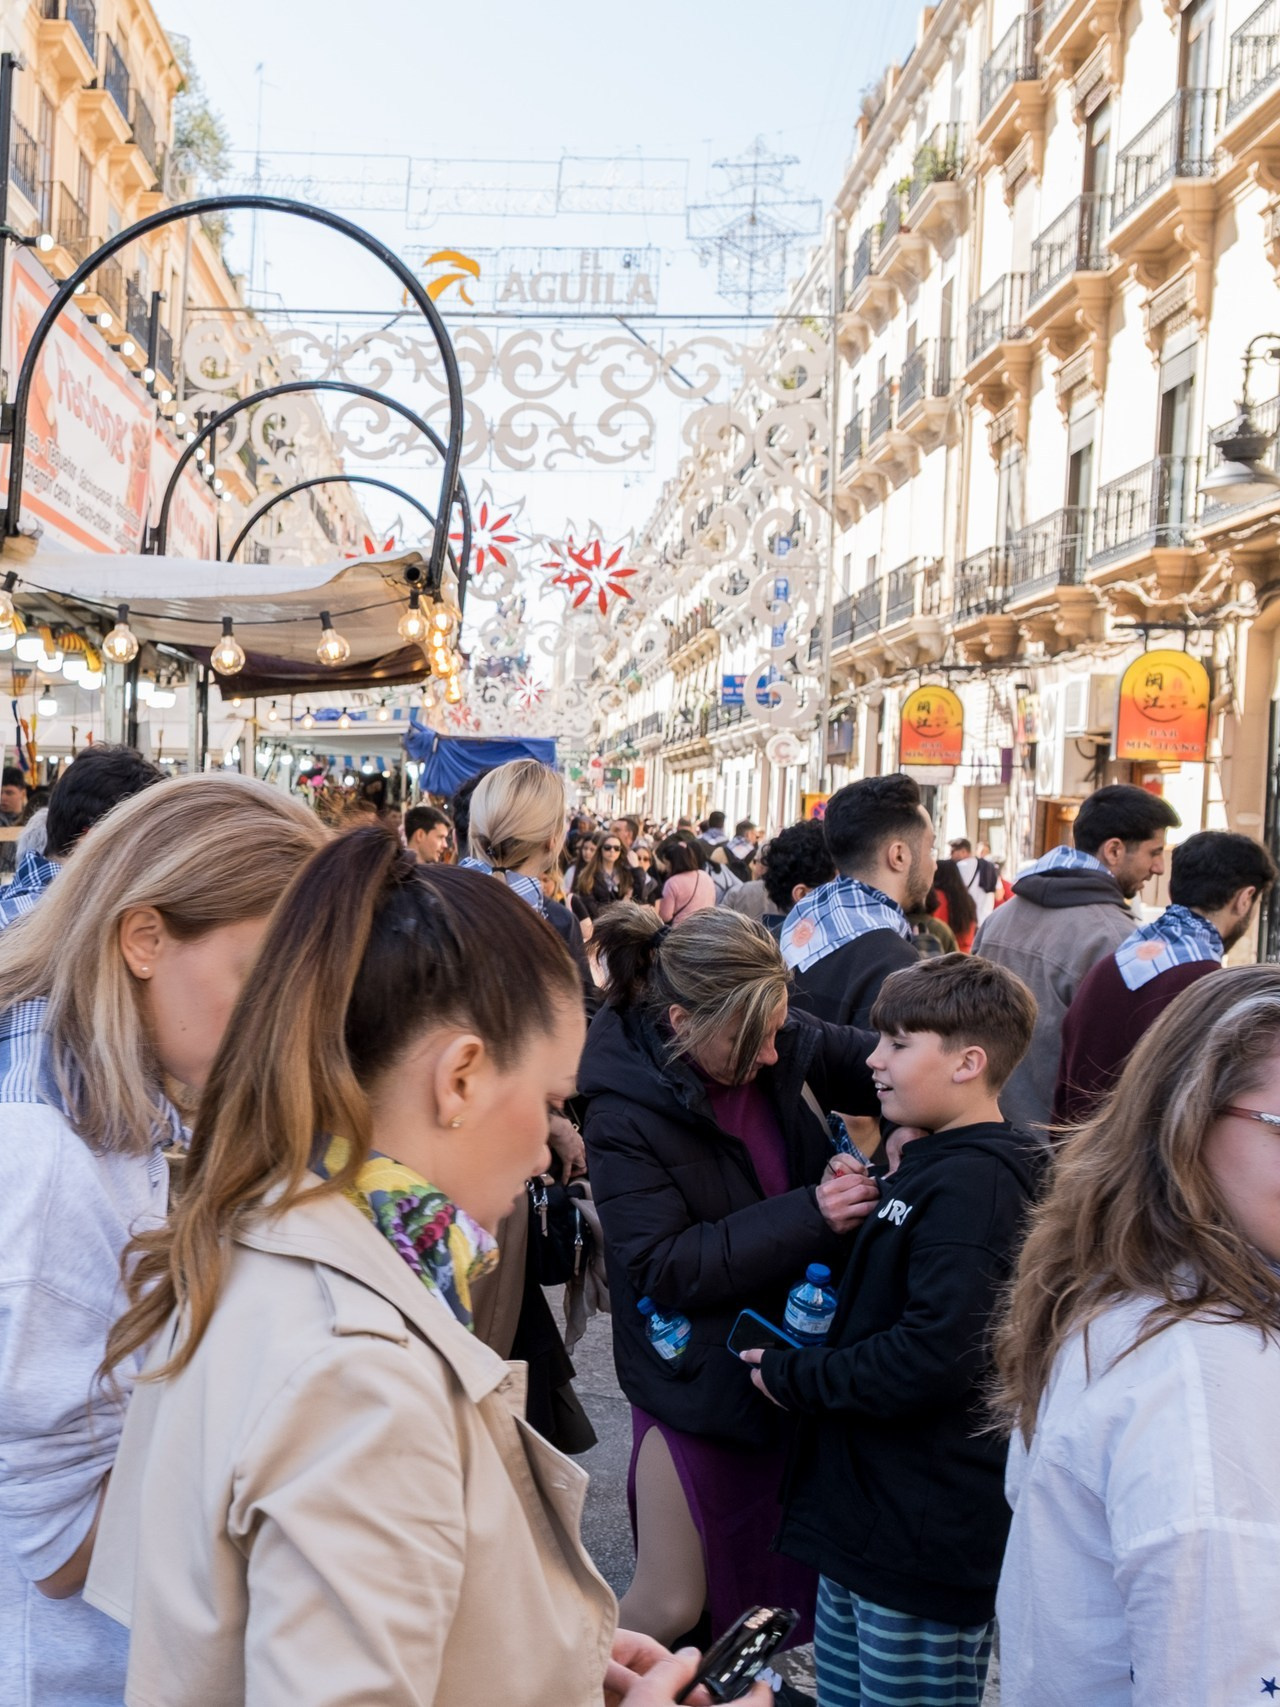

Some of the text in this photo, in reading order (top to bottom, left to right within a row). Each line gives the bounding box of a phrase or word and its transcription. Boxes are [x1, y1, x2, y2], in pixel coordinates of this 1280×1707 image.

[580, 251, 603, 270] EL
[1126, 740, 1200, 752] MIN JIANG
